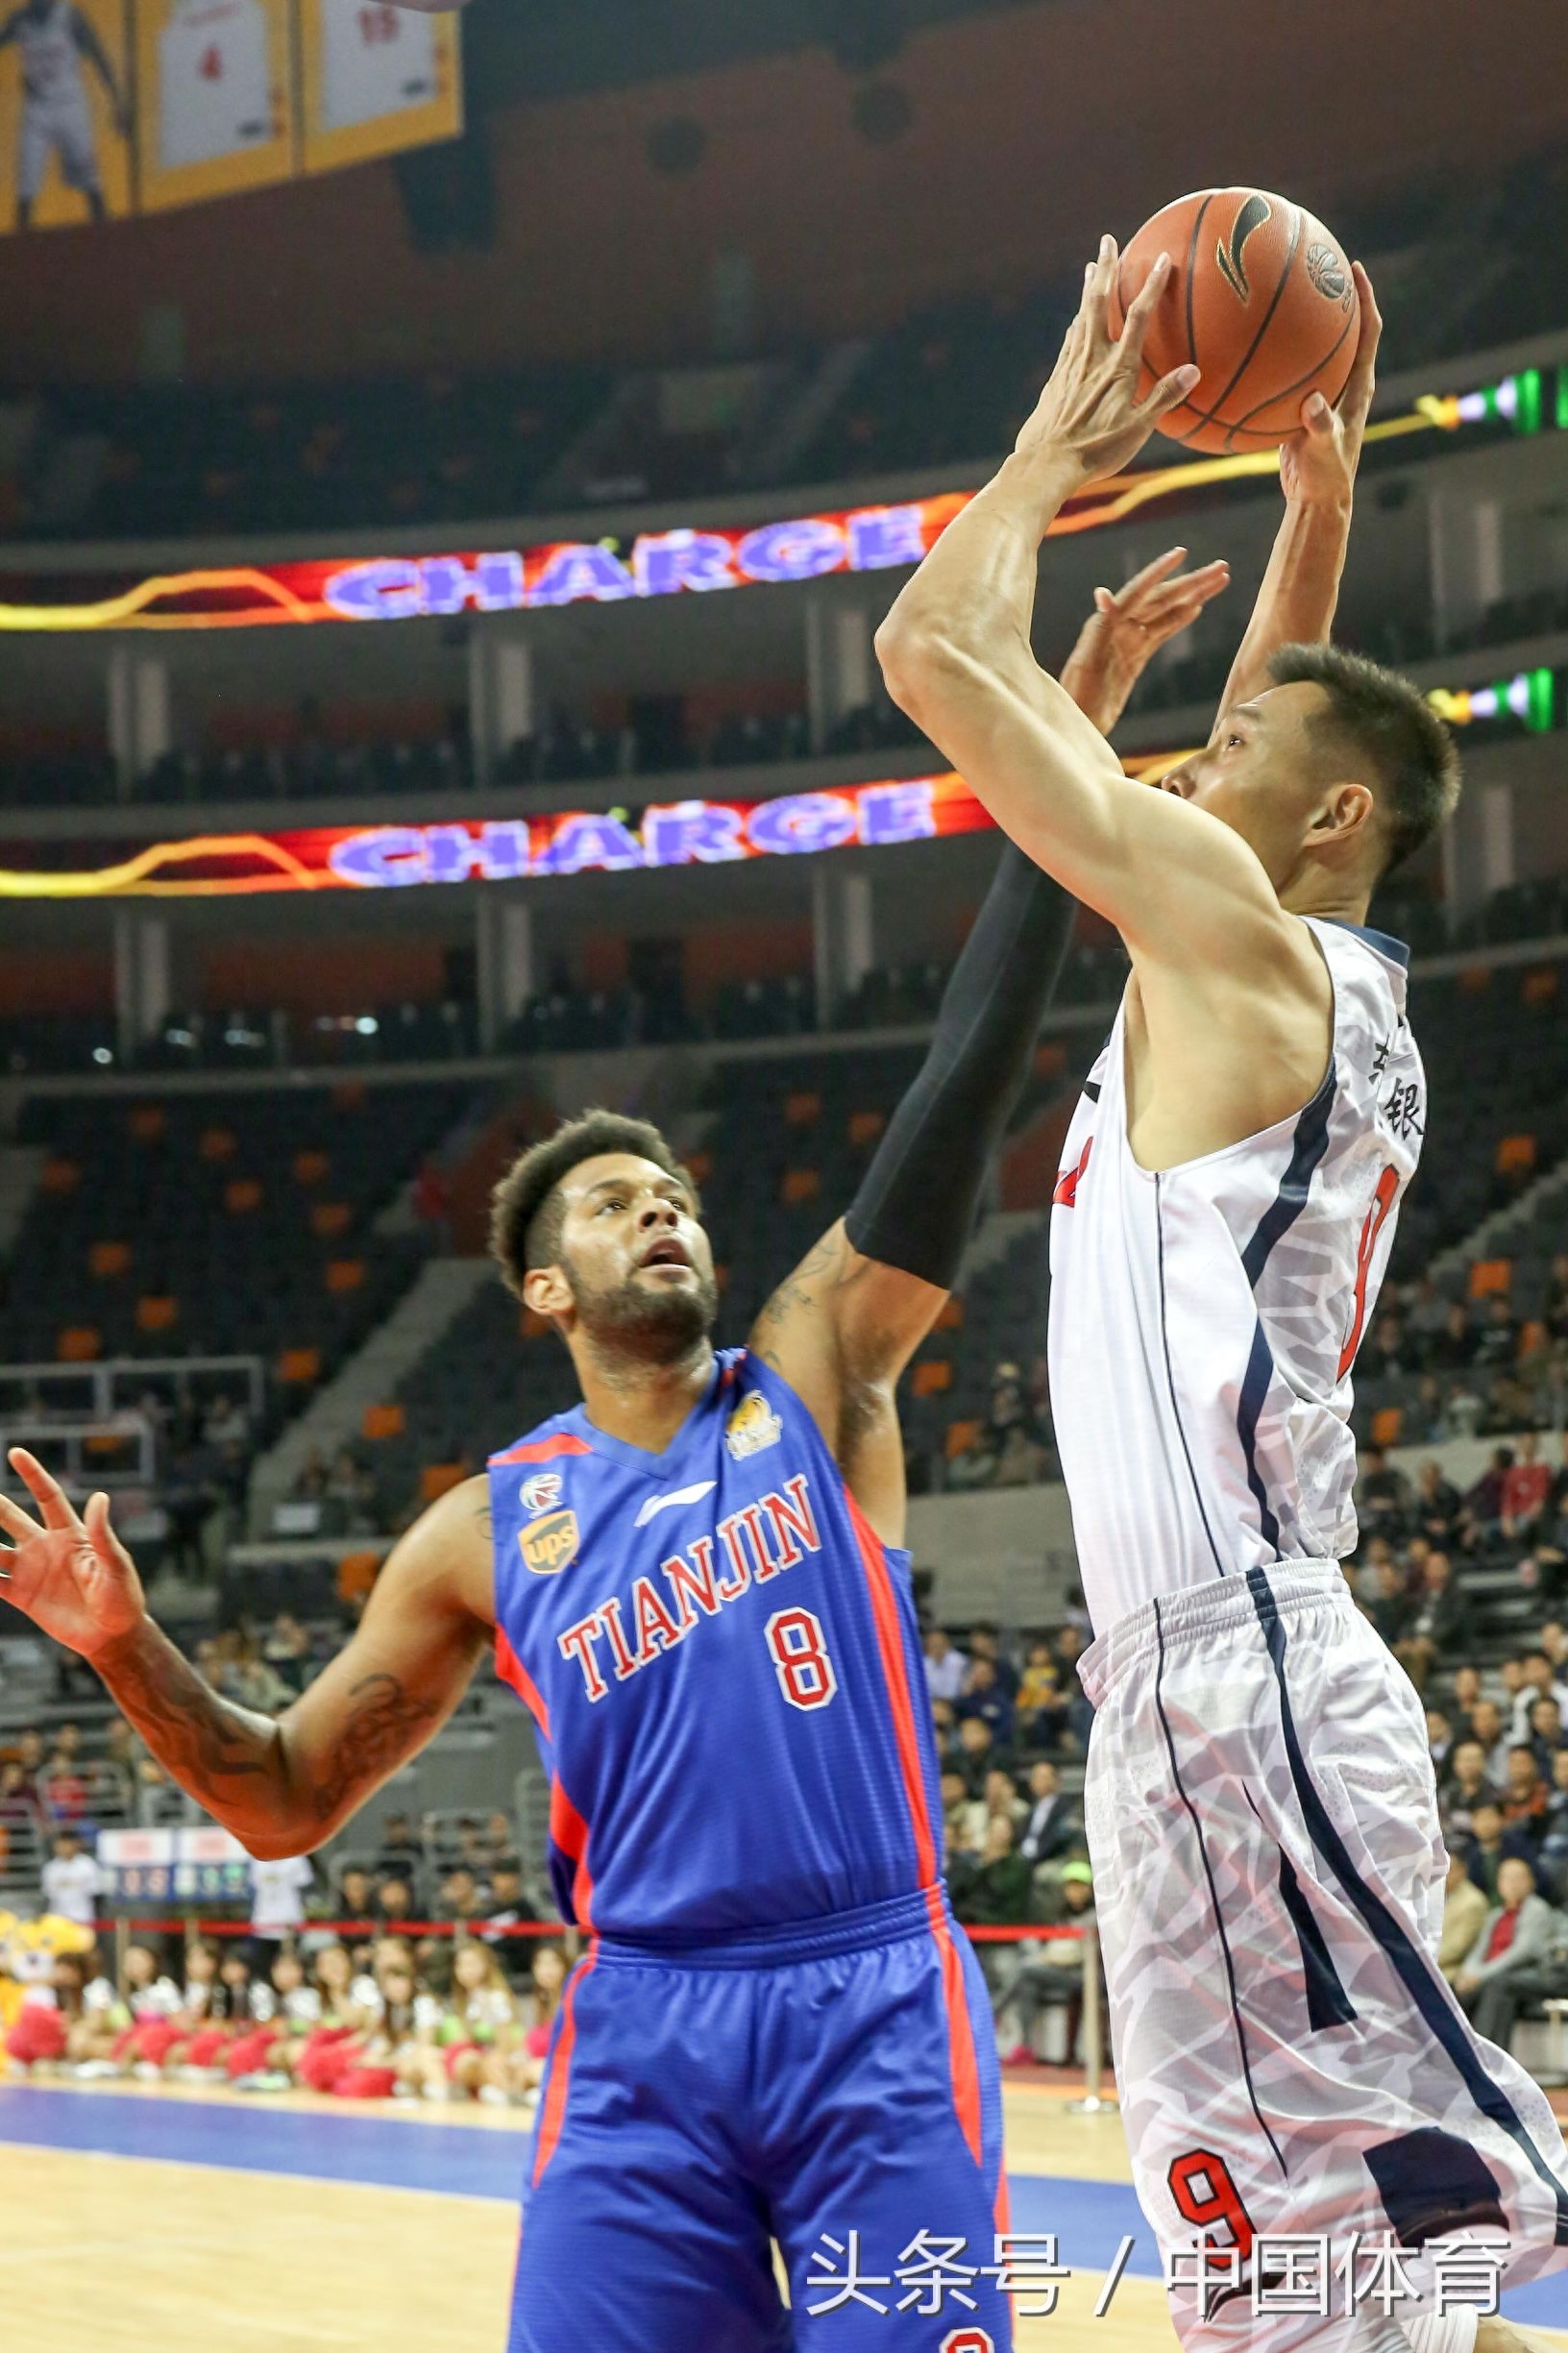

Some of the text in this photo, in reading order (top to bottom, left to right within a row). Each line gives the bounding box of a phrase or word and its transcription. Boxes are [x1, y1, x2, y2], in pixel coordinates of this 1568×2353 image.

[325, 505, 923, 620] CHARGE
[329, 781, 938, 887] CHARGE
[557, 1473, 822, 1703] TIANJIN
[764, 1605, 838, 1711] 8
[1167, 2148, 1258, 2272] 9
